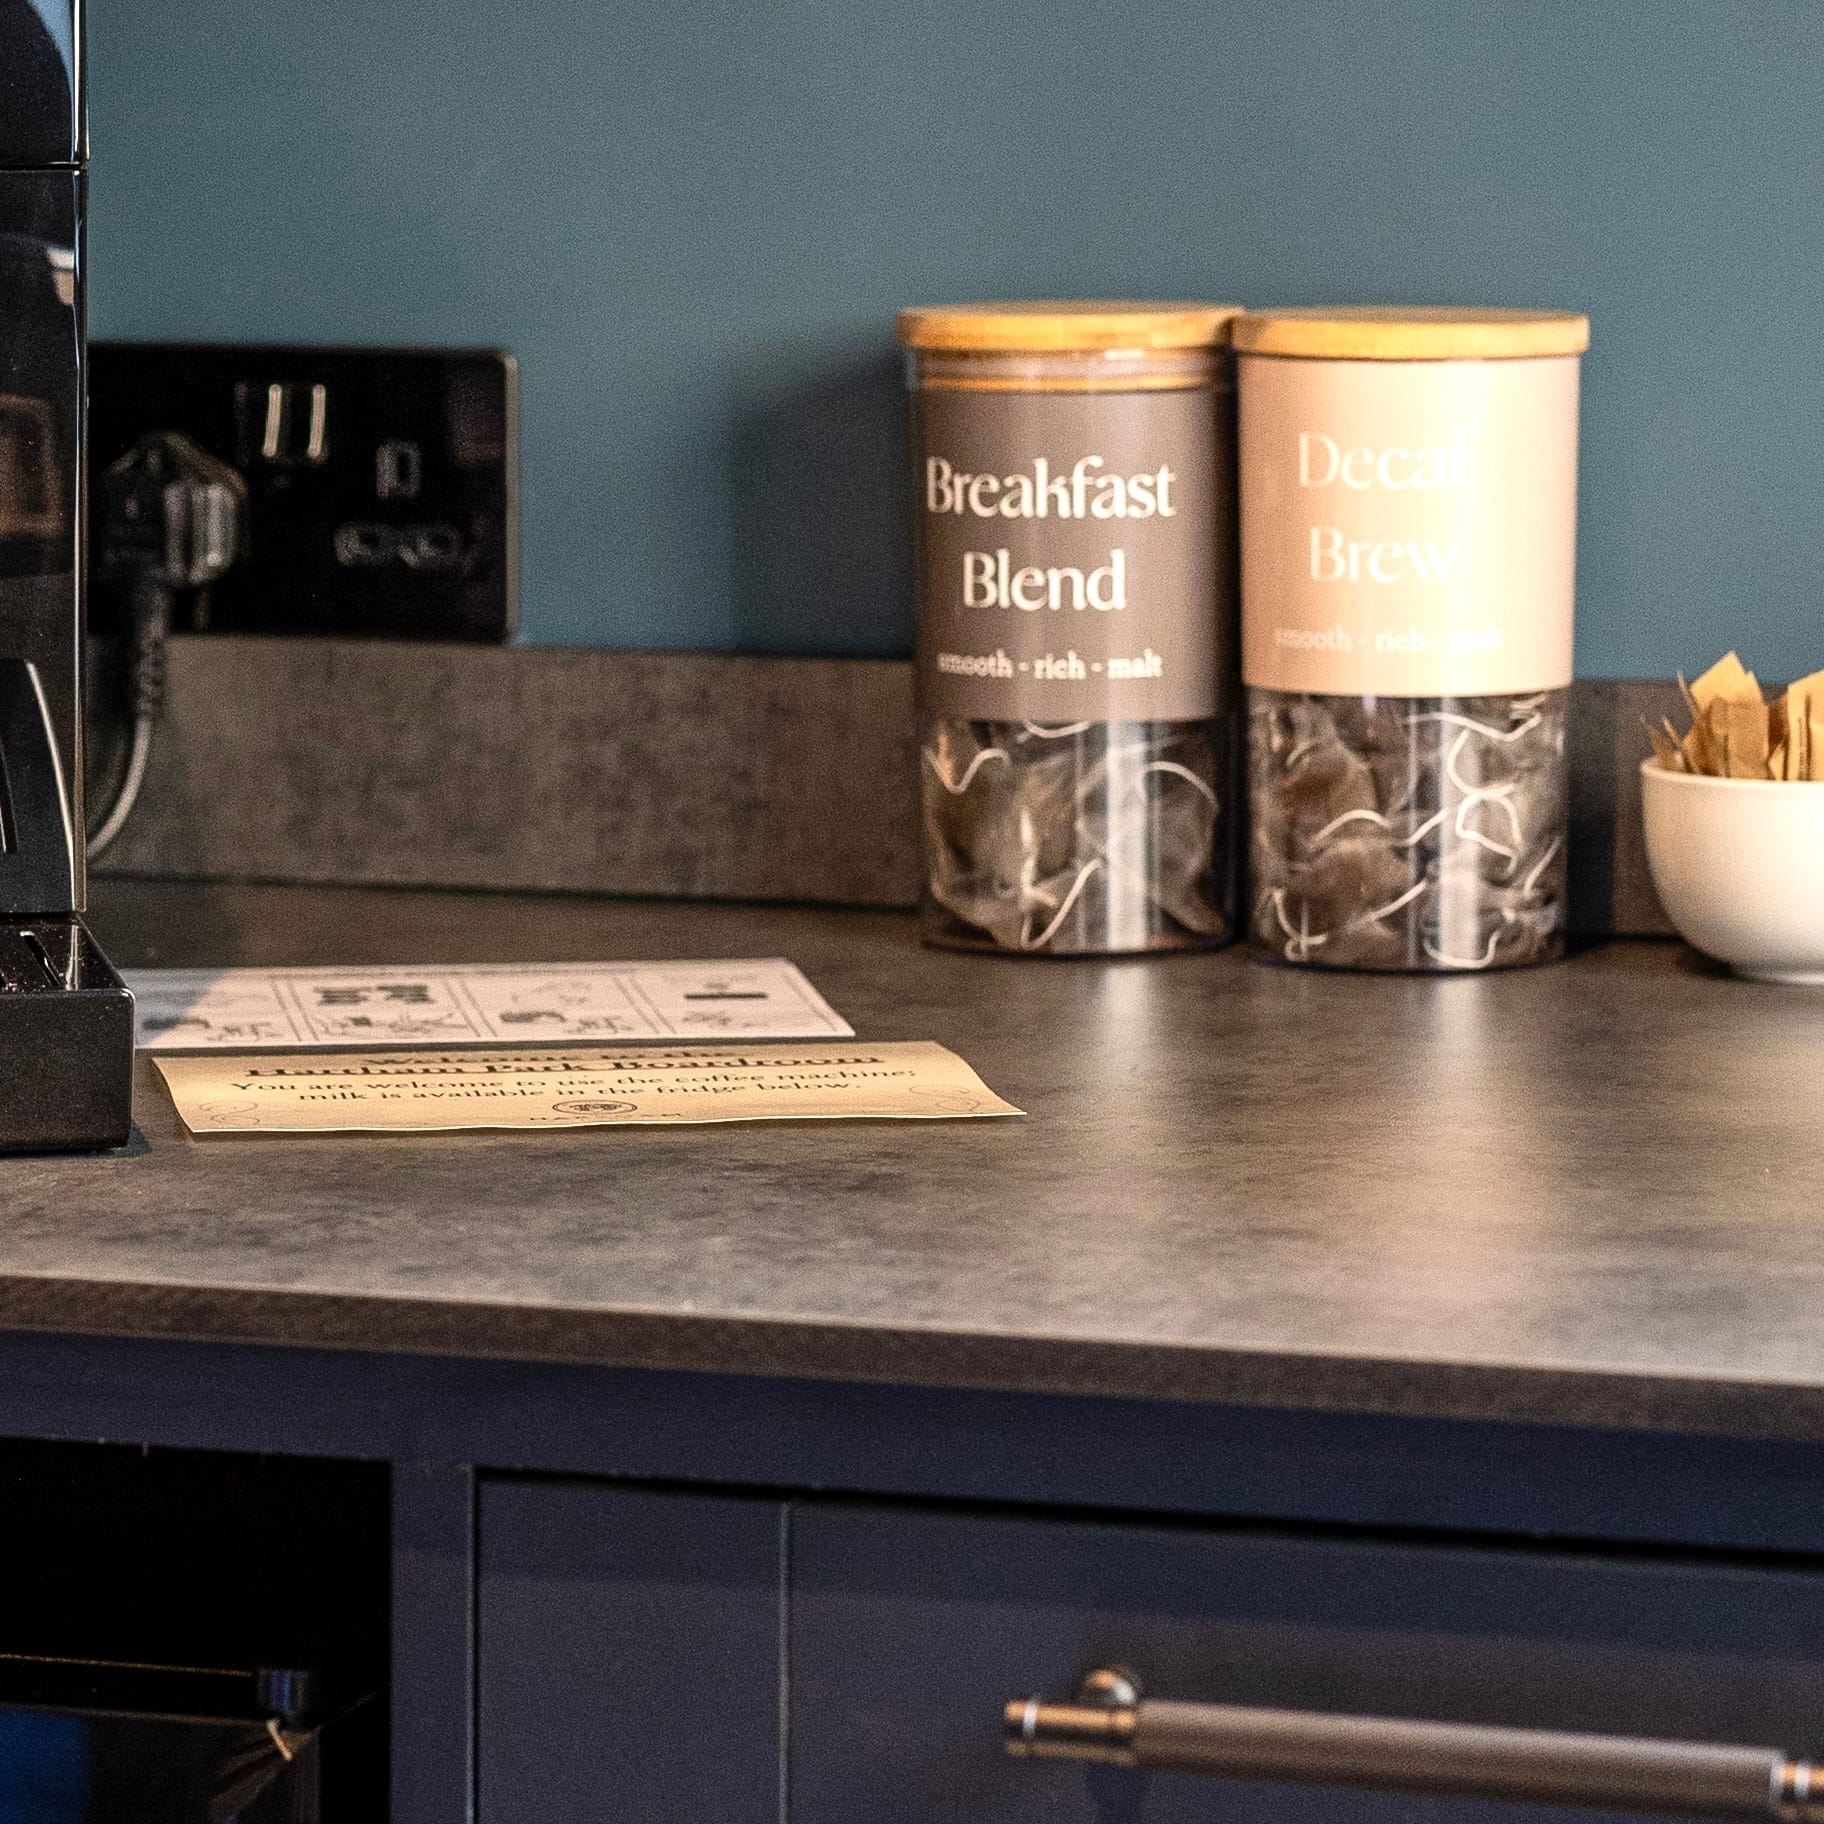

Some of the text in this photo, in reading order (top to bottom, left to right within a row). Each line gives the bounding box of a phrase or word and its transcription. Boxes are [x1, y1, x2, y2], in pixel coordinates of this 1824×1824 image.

[1298, 428, 1480, 491] Decaf
[927, 454, 1176, 519] Breakfast
[1309, 526, 1457, 584] Brew
[963, 548, 1126, 611] Blend
[1033, 648, 1086, 679] rich
[1107, 647, 1163, 679] malt
[367, 1080, 504, 1089] welcome
[675, 1074, 766, 1083] coffee
[610, 1057, 885, 1069] Boardroom
[298, 1092, 368, 1101] milk
[413, 1089, 545, 1099] available
[656, 1084, 746, 1094] fridge
